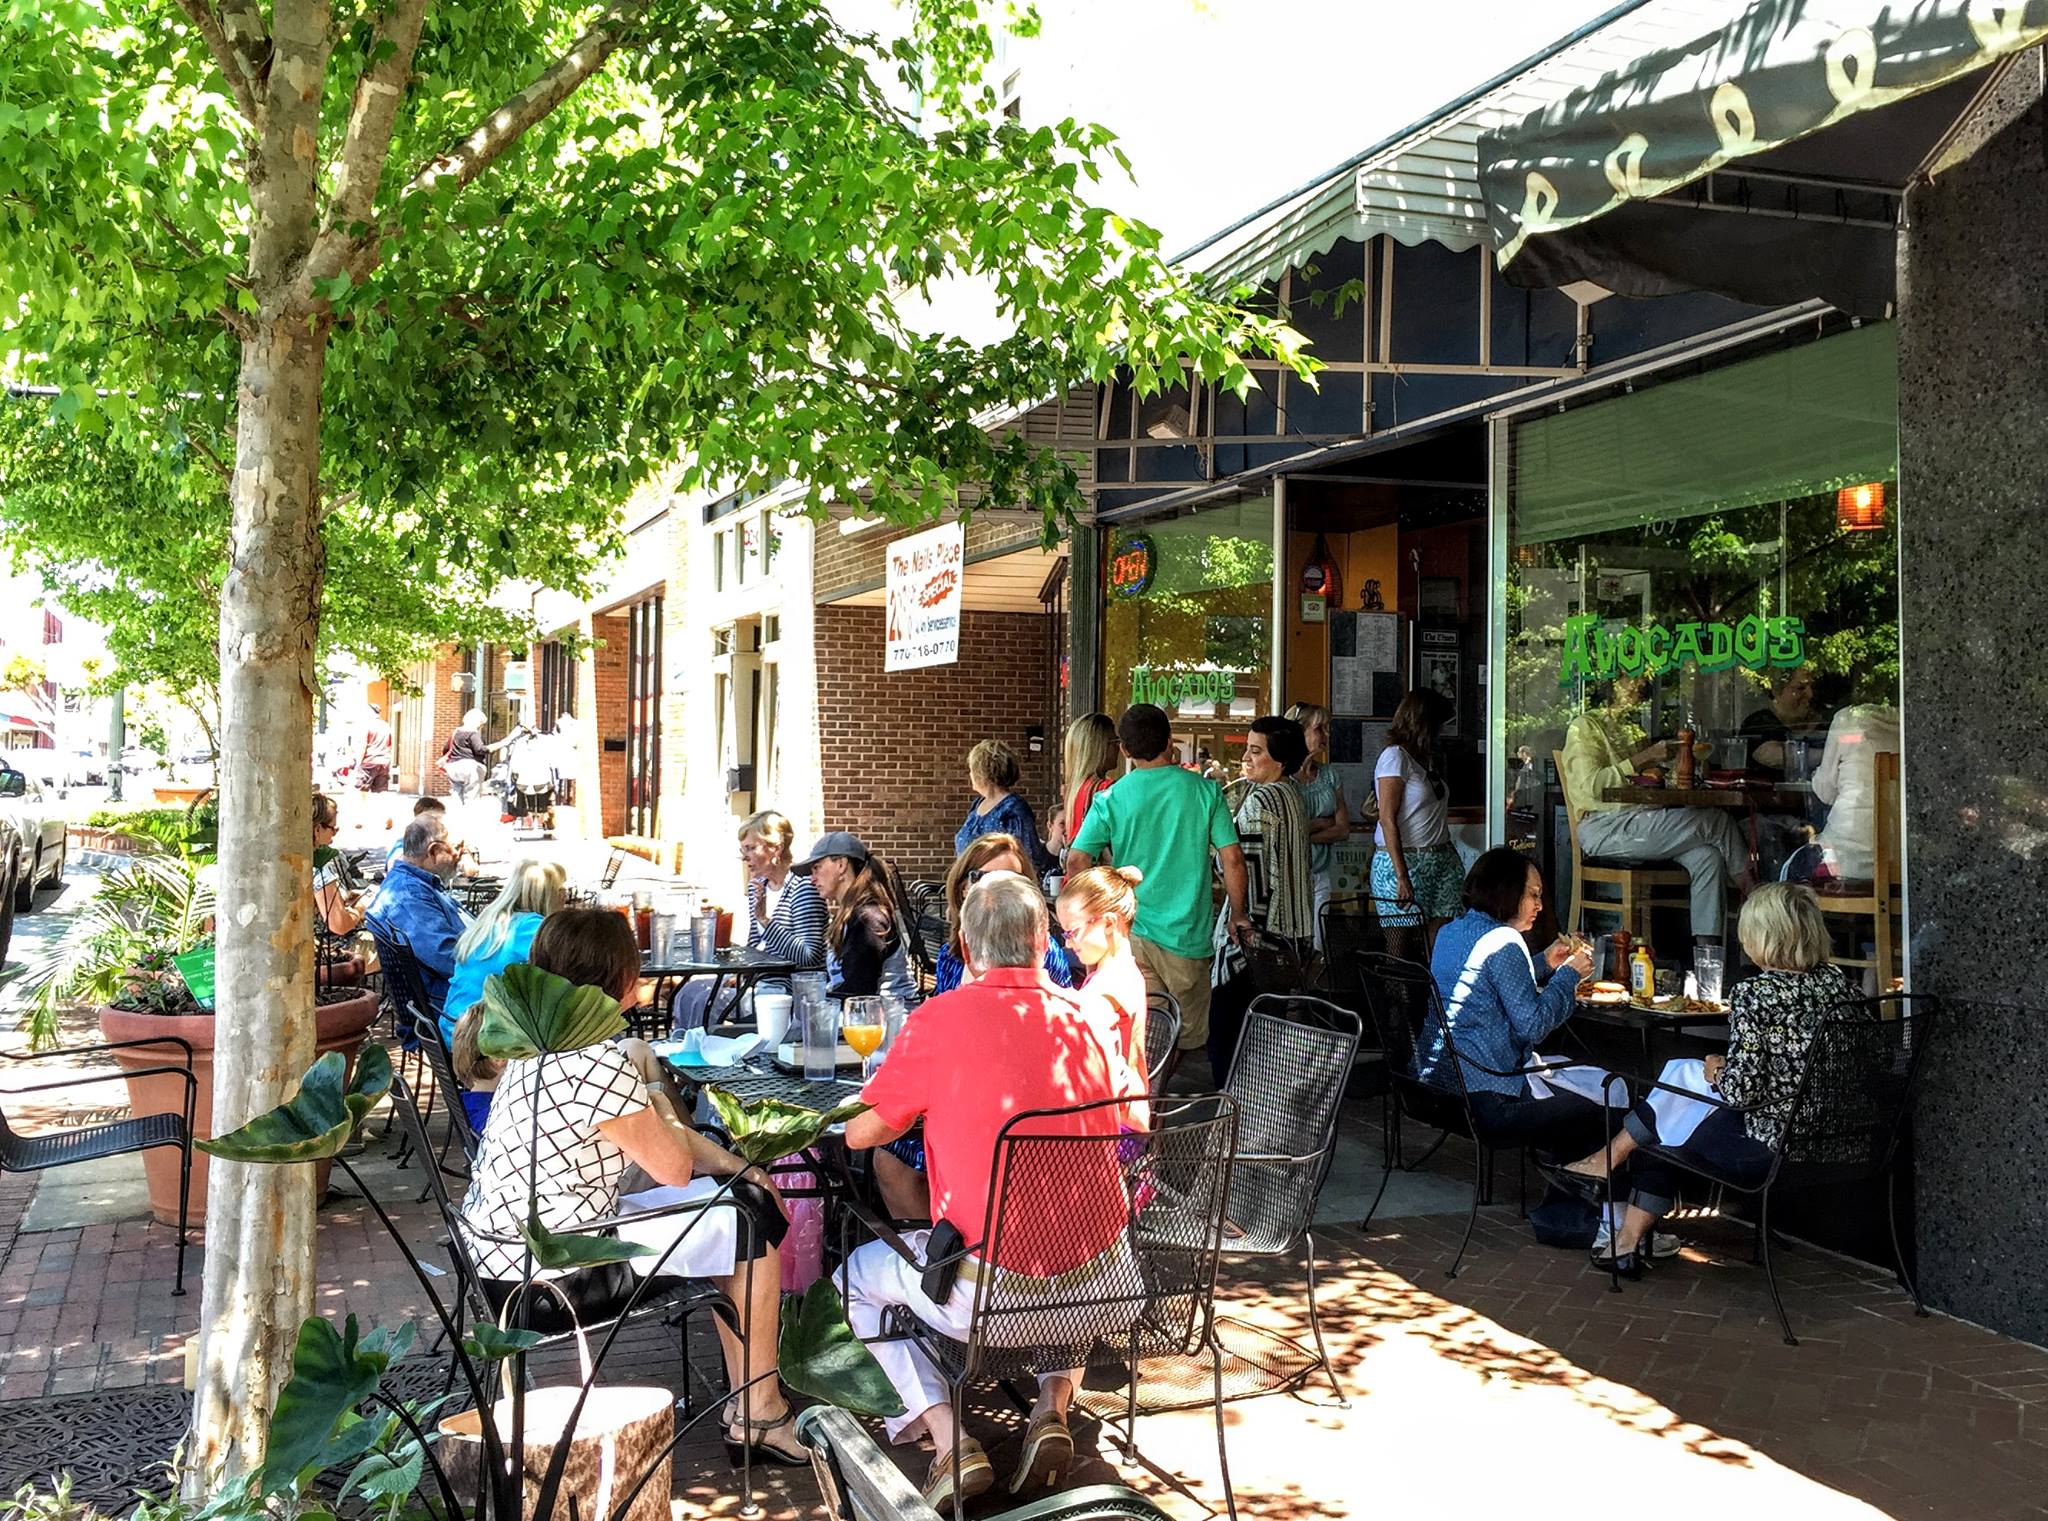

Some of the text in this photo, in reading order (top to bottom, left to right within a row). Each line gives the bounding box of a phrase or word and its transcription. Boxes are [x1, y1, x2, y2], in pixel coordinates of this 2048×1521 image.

[893, 543, 960, 577] The Nails Place
[1113, 550, 1147, 585] OPEN
[1559, 613, 1805, 688] AVOCADOS
[1131, 667, 1235, 708] AVOCADOS
